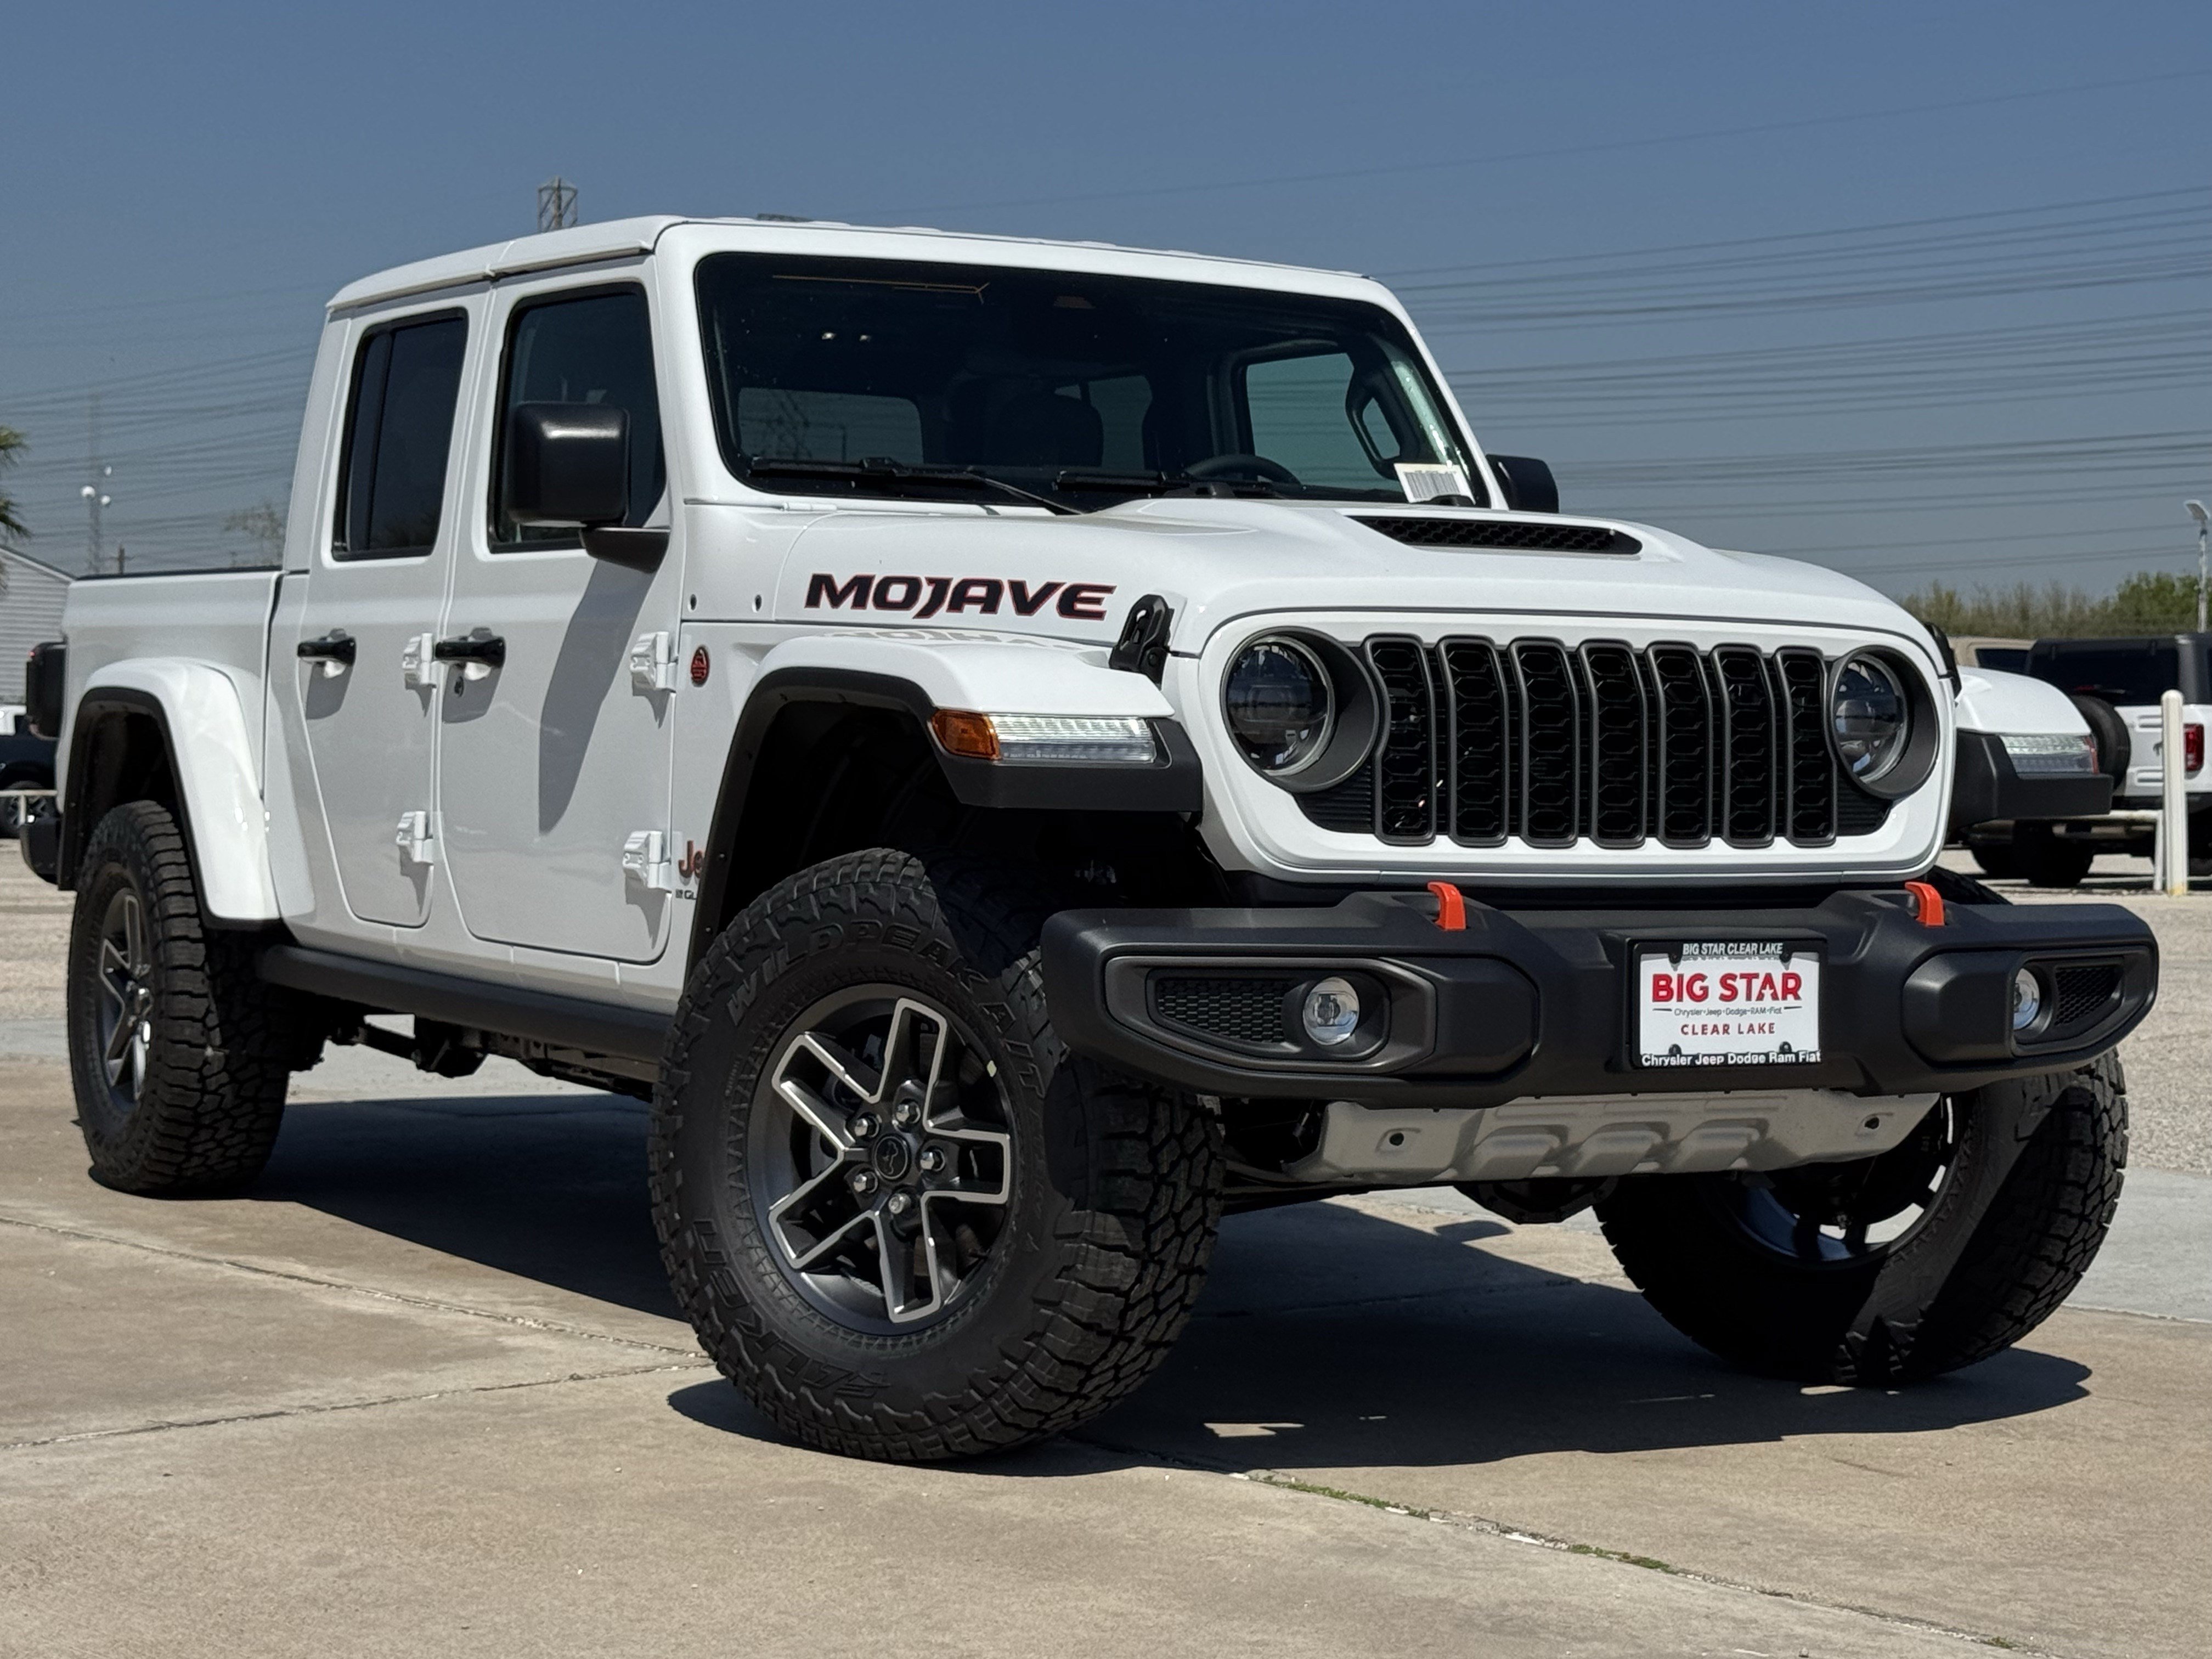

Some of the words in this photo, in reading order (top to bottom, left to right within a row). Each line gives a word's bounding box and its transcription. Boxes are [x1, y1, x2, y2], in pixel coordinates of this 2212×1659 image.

[804, 573, 1118, 621] MOJAVE
[678, 840, 704, 878] Je
[1683, 943, 1700, 955] BIG
[1701, 943, 1726, 955] STAR
[1728, 943, 1758, 955] CLEAR
[1759, 942, 1783, 954] LAKE
[726, 918, 990, 1027] WILDPEAK
[1652, 973, 1709, 1003] BIG
[1719, 972, 1802, 1002] STAR
[1680, 1023, 1730, 1035] CLEAR
[1738, 1023, 1775, 1035] LAKE
[1641, 1053, 1693, 1066] Chrysler
[1695, 1053, 1725, 1065] Jeep
[1728, 1052, 1766, 1065] Dodge
[1769, 1051, 1796, 1063] Ram
[1798, 1050, 1821, 1063] Fiat
